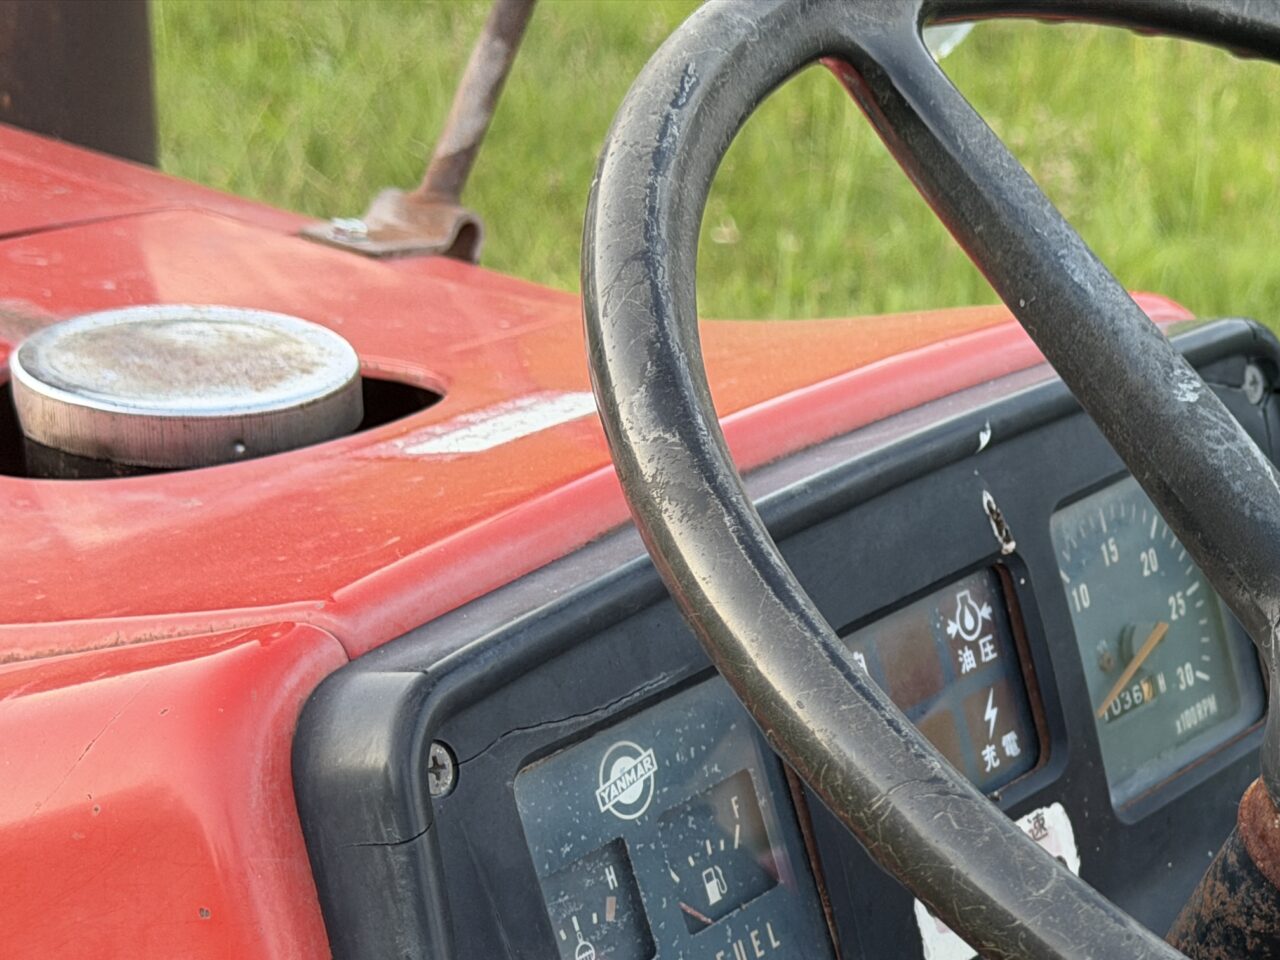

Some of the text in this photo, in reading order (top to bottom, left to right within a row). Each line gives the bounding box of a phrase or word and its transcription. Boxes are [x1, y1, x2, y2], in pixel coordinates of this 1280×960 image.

[1101, 537, 1119, 567] 15
[1140, 548, 1159, 577] 20
[1072, 583, 1090, 613] 10
[1168, 591, 1187, 621] 25
[957, 634, 998, 674] 油圧
[1176, 662, 1195, 690] 30
[981, 730, 1022, 773] 充電
[600, 756, 653, 804] YANMAR
[731, 795, 740, 819] F
[604, 865, 619, 890] H
